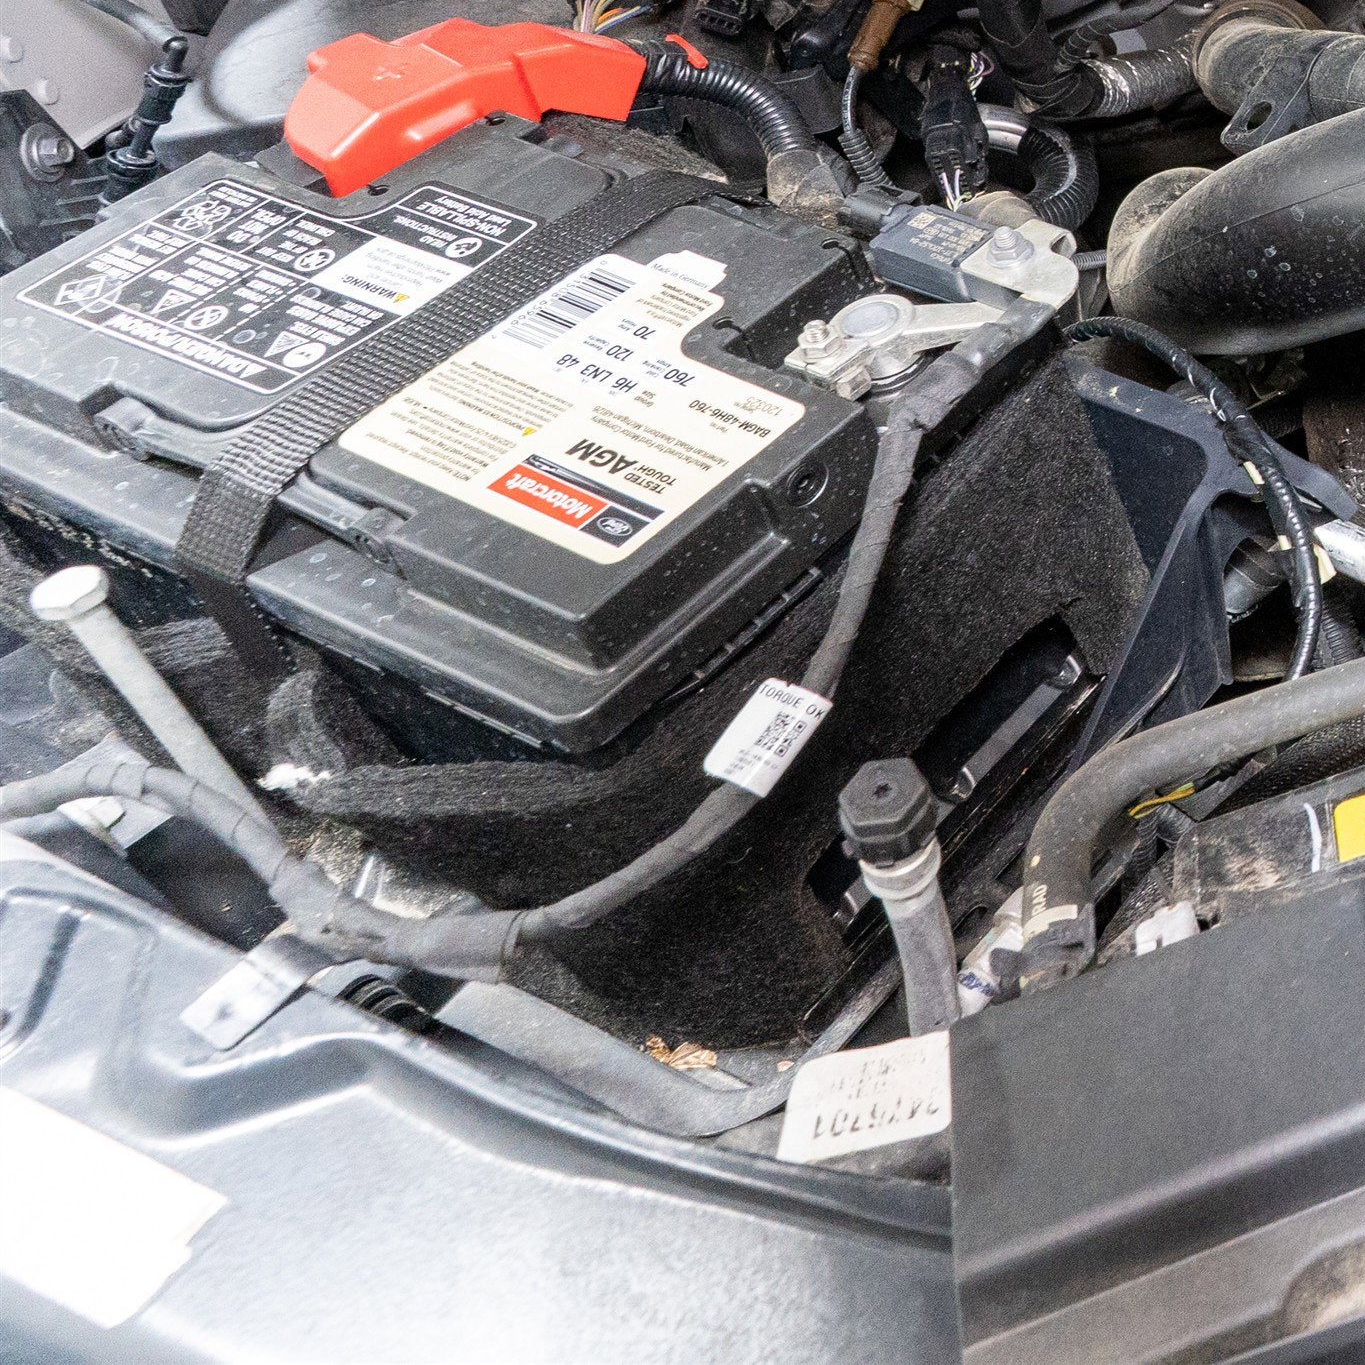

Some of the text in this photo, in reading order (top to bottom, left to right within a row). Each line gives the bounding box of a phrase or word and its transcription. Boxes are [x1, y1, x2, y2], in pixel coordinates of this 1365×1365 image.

[246, 208, 288, 226] OPEN.
[413, 201, 508, 236] NON-SPILLABLE
[430, 195, 512, 226] Lead Acid Battery
[224, 229, 253, 243] DO
[236, 219, 271, 234] NOT
[417, 235, 448, 248] READ
[336, 273, 400, 299] WARNING:
[630, 324, 657, 340] 70
[102, 312, 253, 373] DANGER/POISON
[603, 343, 635, 361] 120
[554, 353, 638, 393] H6 LN3 48
[661, 367, 696, 387] 760
[631, 395, 655, 407] Group
[639, 389, 657, 399] Size
[609, 412, 645, 431] Michigan
[686, 398, 772, 438] BAGM-48H6-760
[587, 414, 713, 472] Manufactured for Ford Motor Company
[563, 437, 639, 477] AGM
[690, 447, 726, 466] American
[621, 471, 668, 494] TESTED
[500, 472, 594, 519] Motorcraft
[599, 517, 631, 536] Ford
[760, 684, 825, 720] TORQUE OK
